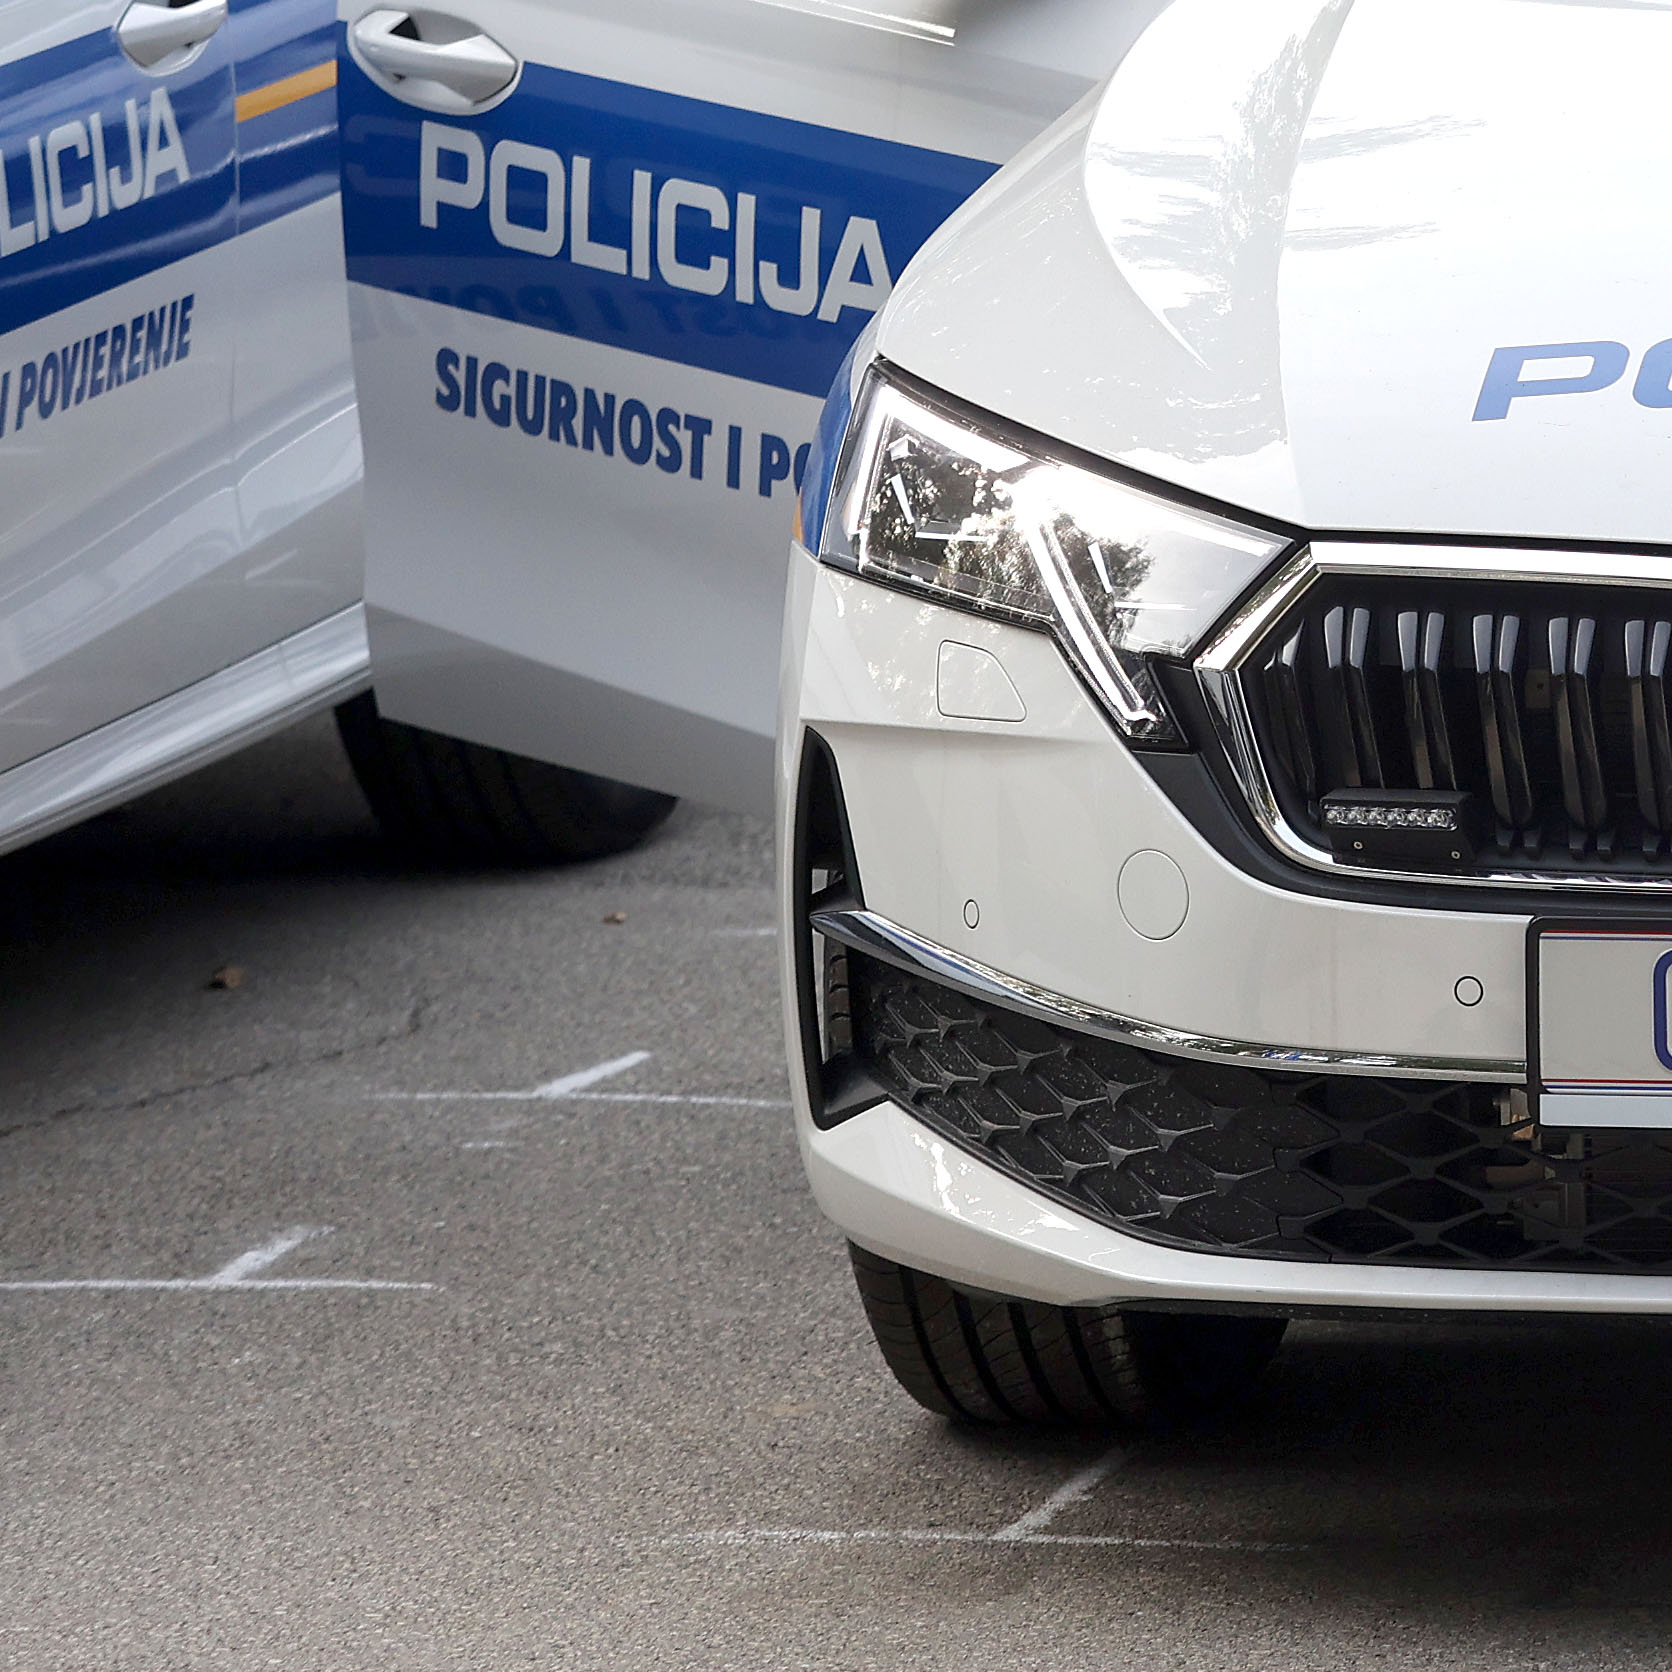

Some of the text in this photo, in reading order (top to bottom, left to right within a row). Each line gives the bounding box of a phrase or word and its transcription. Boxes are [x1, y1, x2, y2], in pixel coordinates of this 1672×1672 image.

[419, 120, 893, 324] POLICIJA
[15, 293, 195, 432] POVJERENJE
[434, 347, 713, 480] SIGURNOST
[726, 424, 743, 491] I
